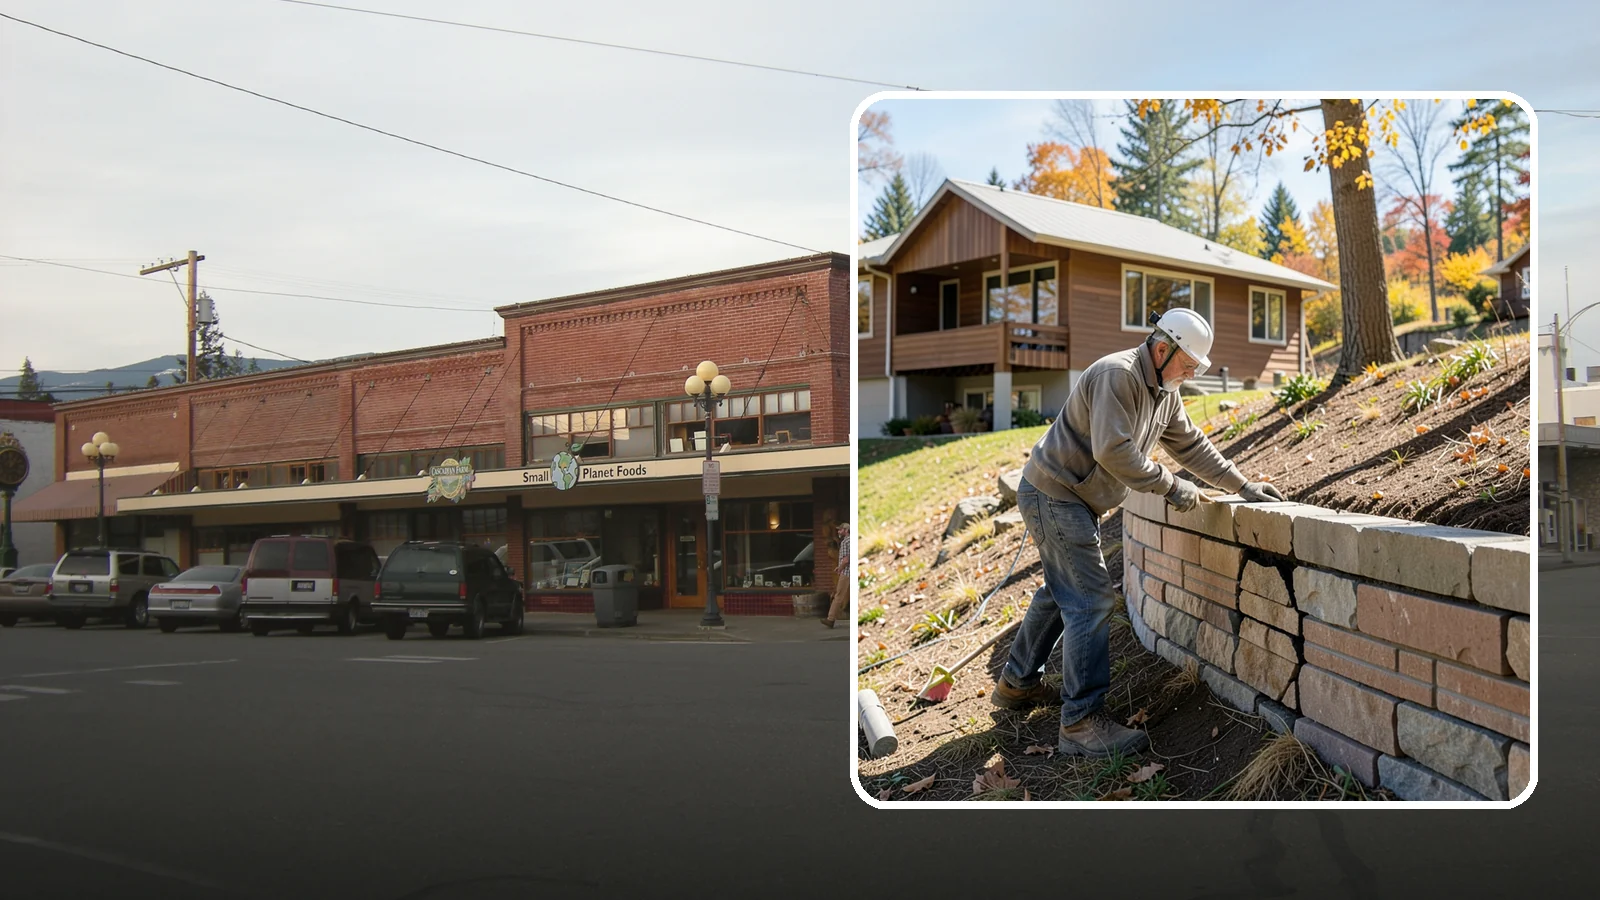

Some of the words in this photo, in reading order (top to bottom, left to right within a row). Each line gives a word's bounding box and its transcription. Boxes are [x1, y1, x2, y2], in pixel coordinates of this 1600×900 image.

[523, 471, 549, 483] Small
[582, 467, 614, 480] Planet
[616, 464, 647, 477] Foods
